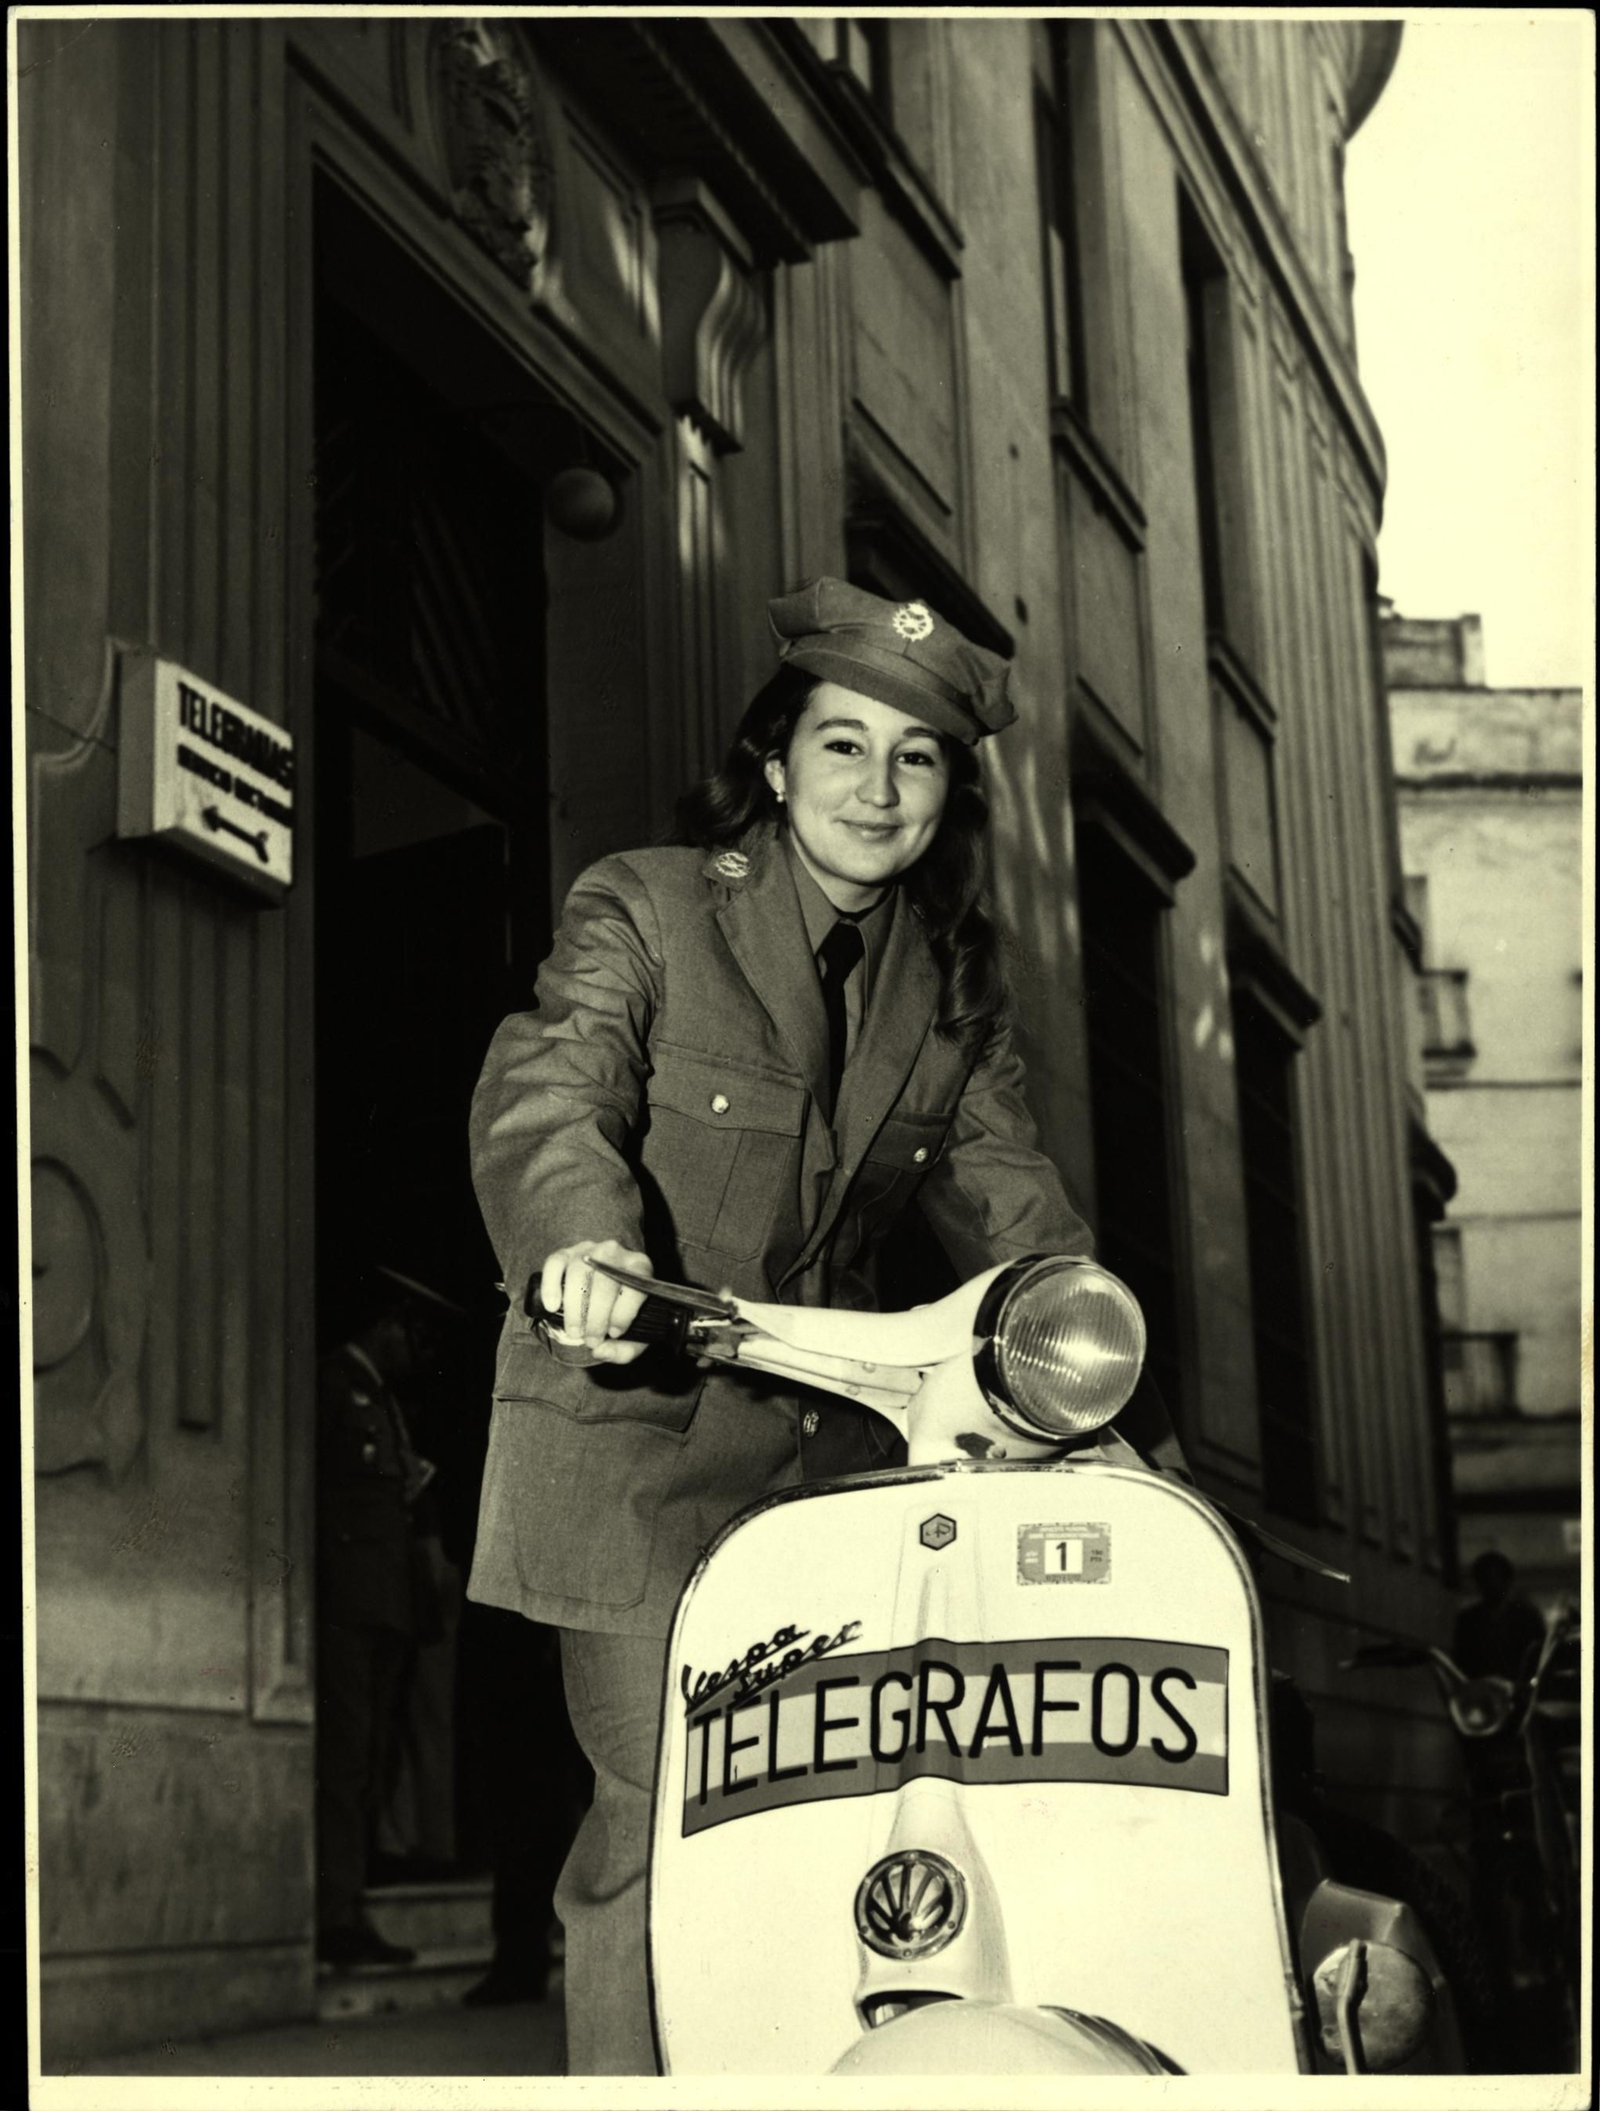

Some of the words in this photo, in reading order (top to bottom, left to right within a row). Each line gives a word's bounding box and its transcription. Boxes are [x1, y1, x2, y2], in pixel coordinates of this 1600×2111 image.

[1055, 1541, 1067, 1571] 1
[681, 1623, 811, 1718] Vespa
[692, 1660, 1198, 1805] TELEGRAFOS
